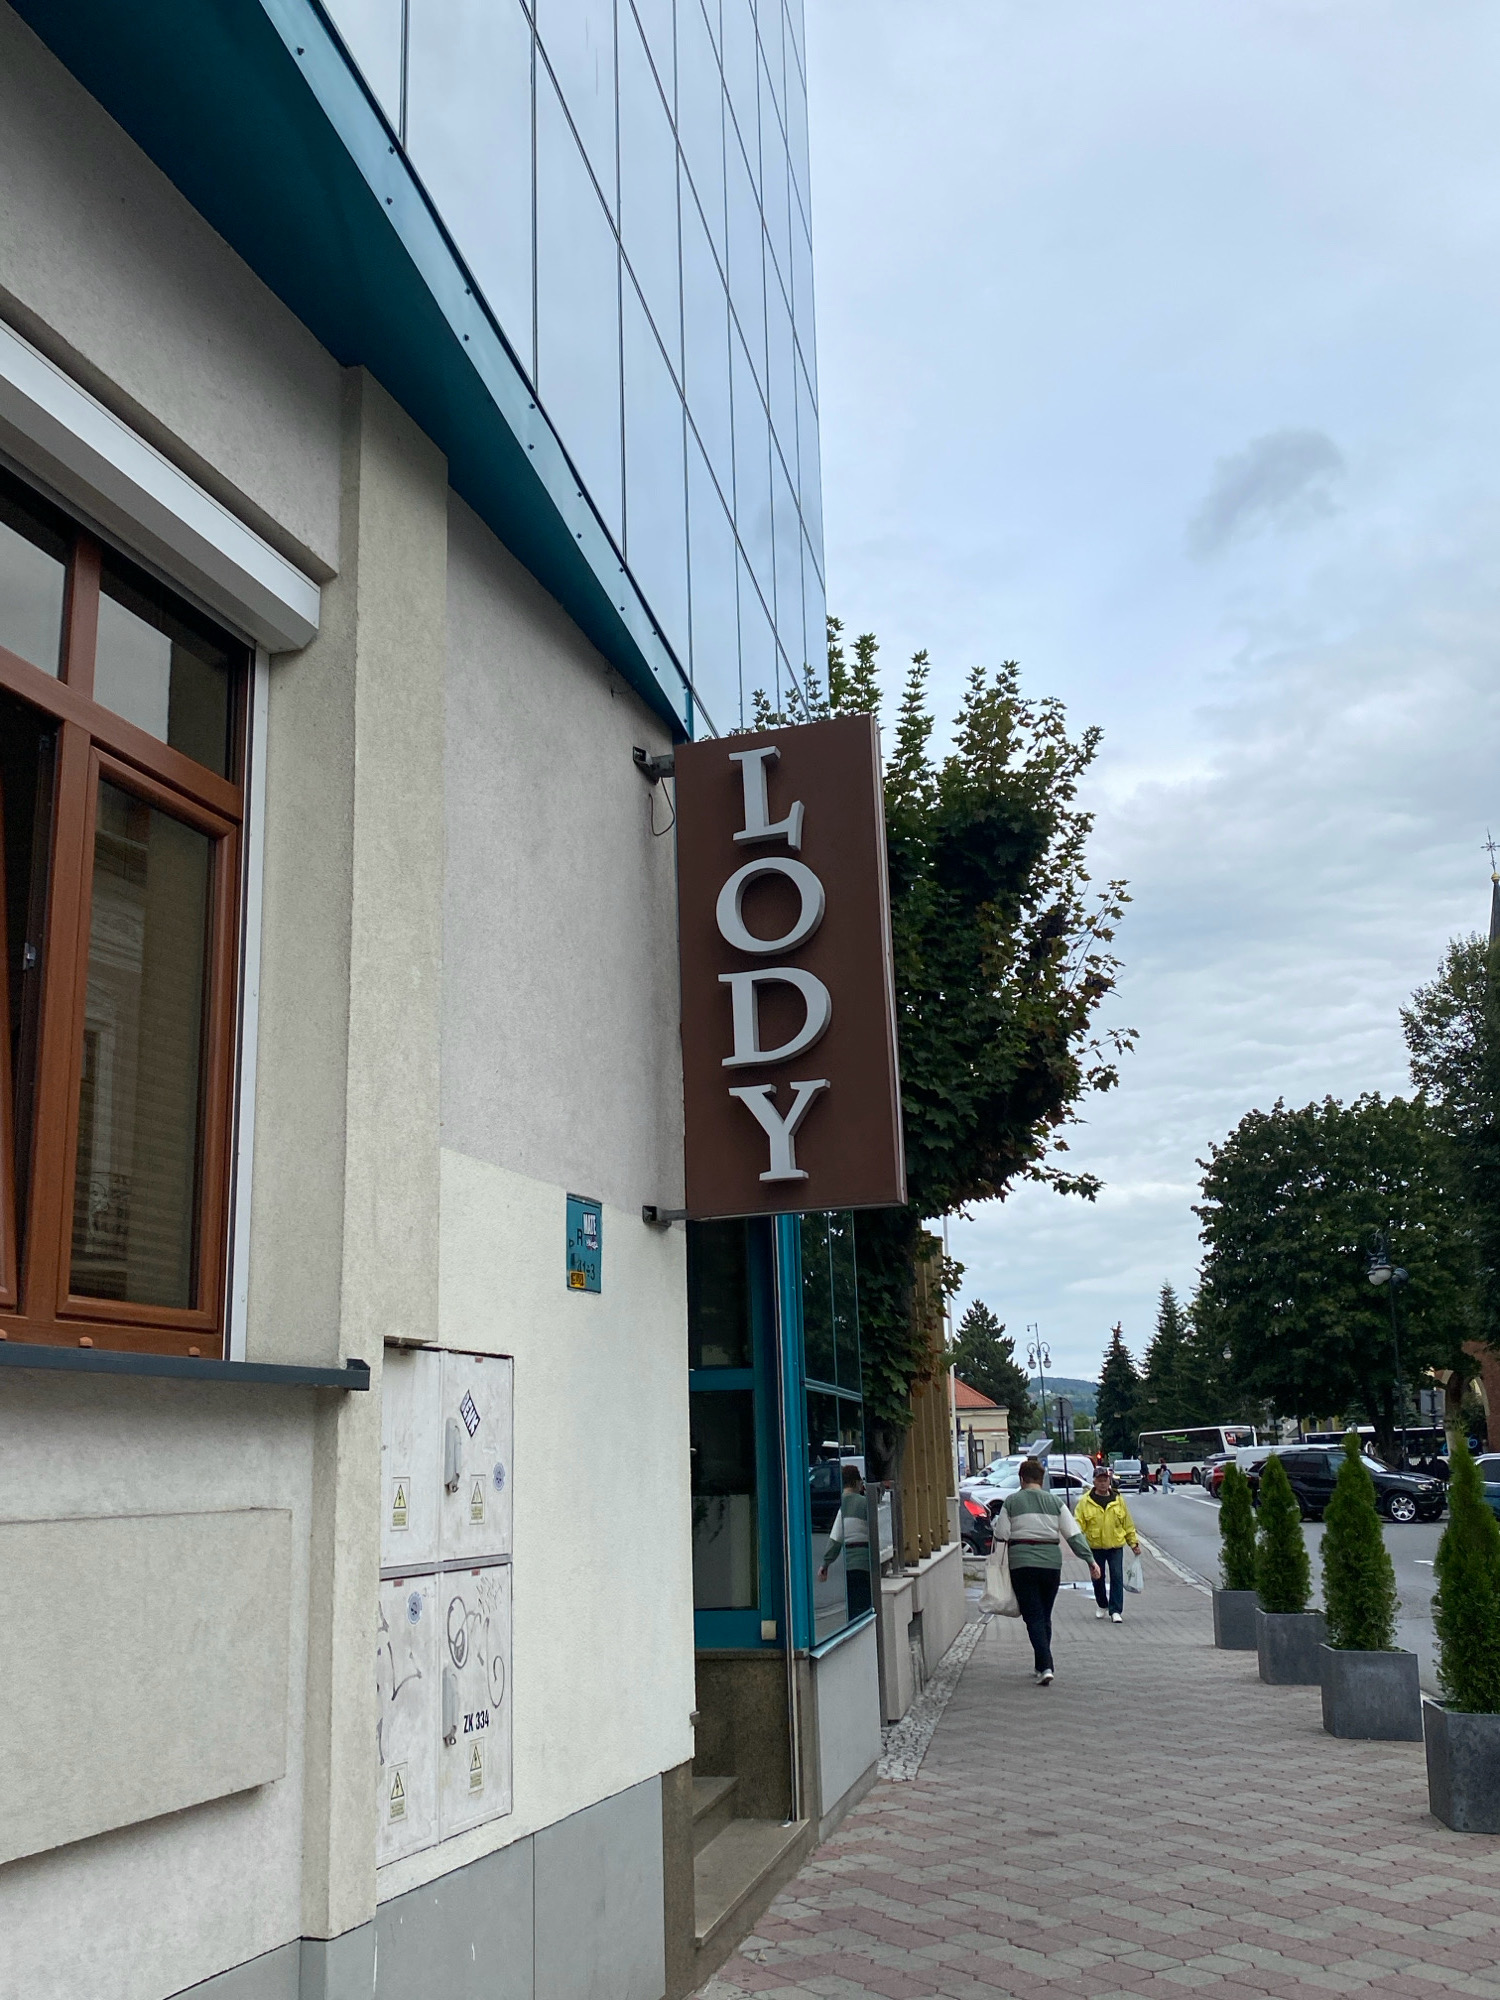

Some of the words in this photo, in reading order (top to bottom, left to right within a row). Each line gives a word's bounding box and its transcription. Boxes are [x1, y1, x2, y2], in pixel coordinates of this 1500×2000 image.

[716, 745, 832, 1183] LODY
[463, 1713, 474, 1734] ZK
[475, 1709, 490, 1730] 334
